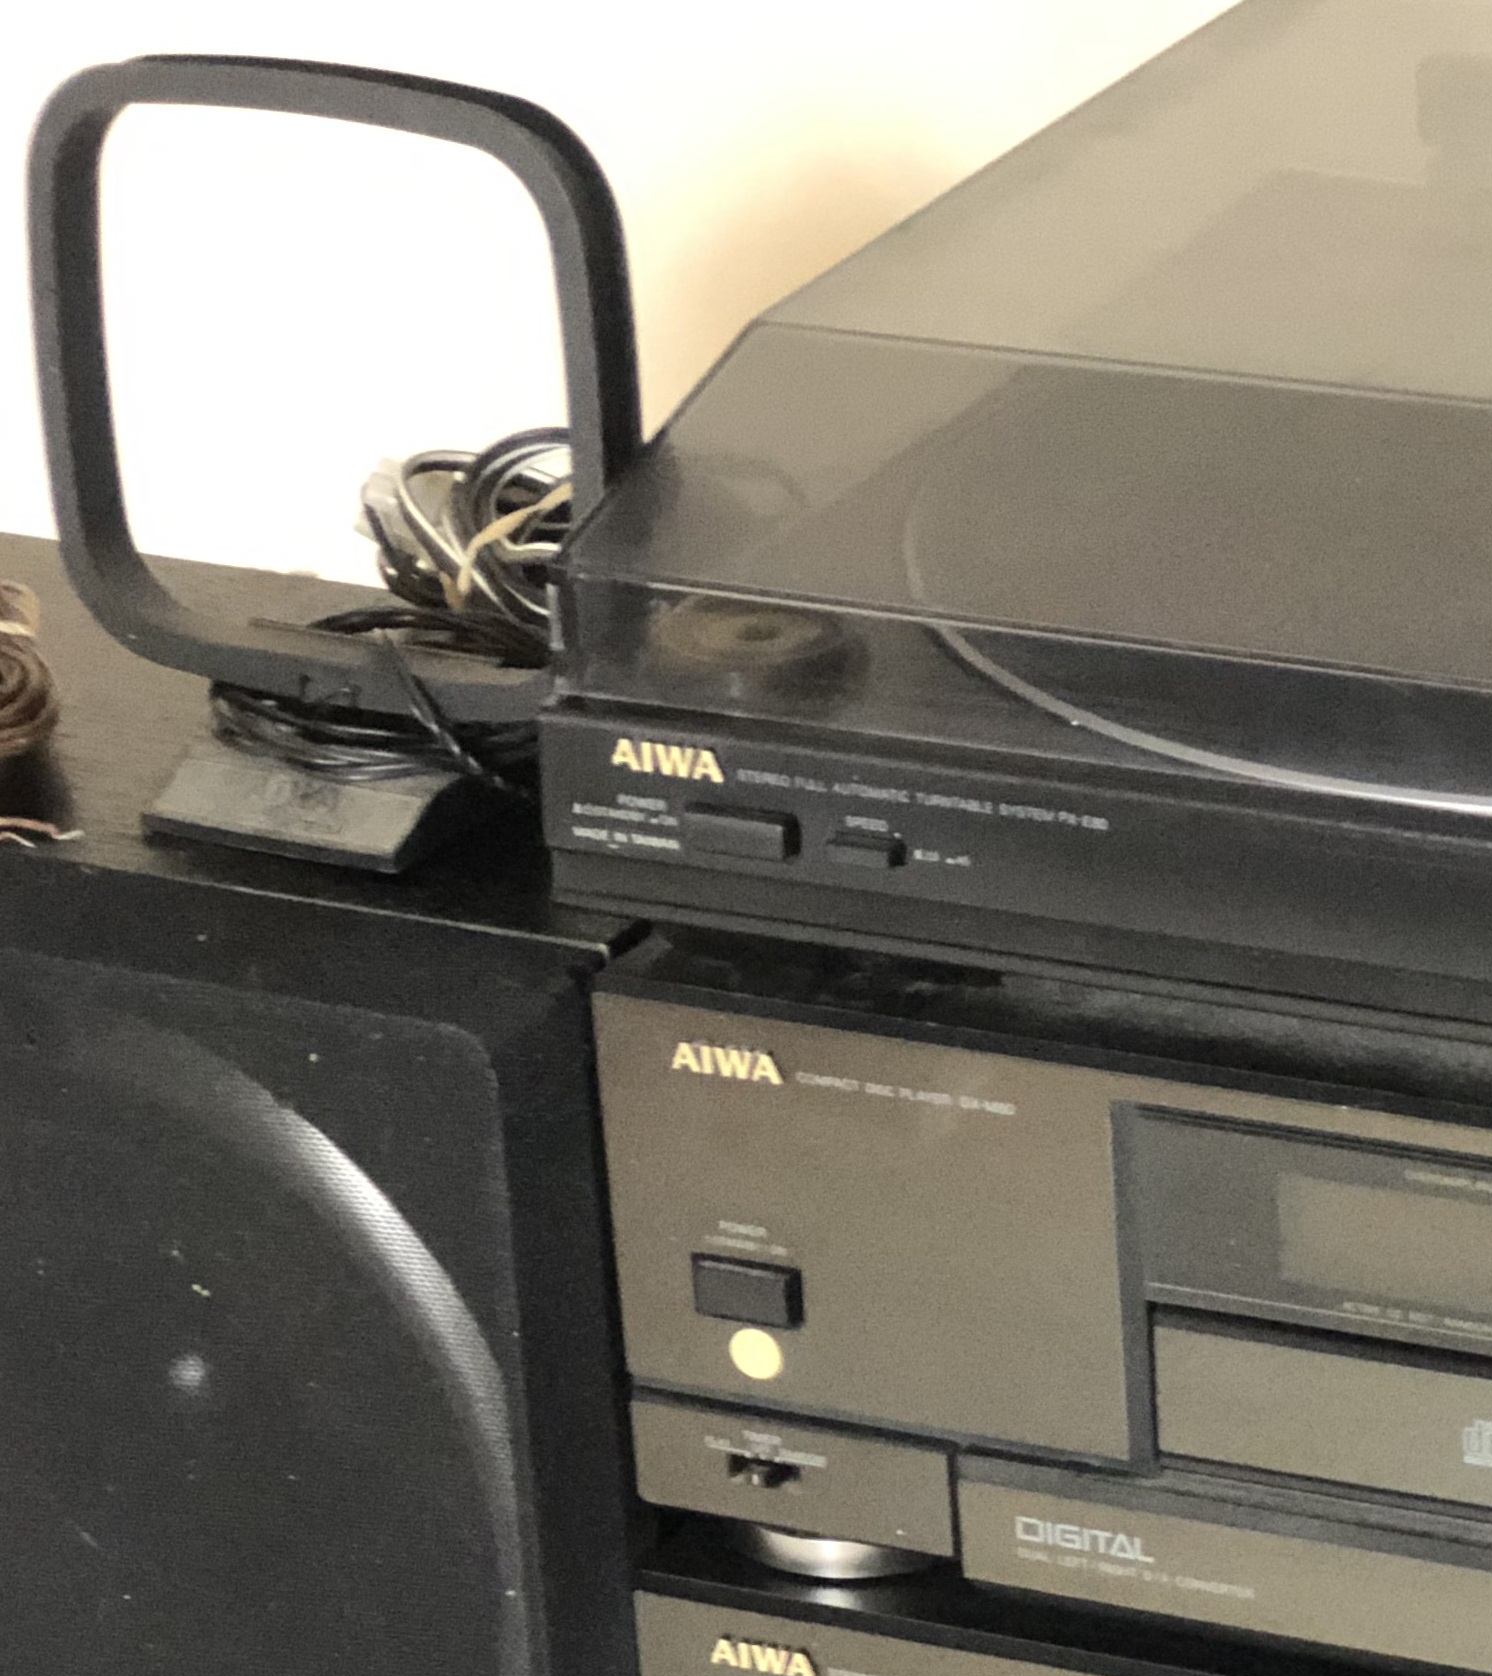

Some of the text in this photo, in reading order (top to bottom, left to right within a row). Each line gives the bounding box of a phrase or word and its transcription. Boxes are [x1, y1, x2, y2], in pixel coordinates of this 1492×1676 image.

[611, 738, 725, 784] AIWA
[672, 1041, 784, 1085] AIWA
[1015, 1516, 1155, 1563] DIGITAL
